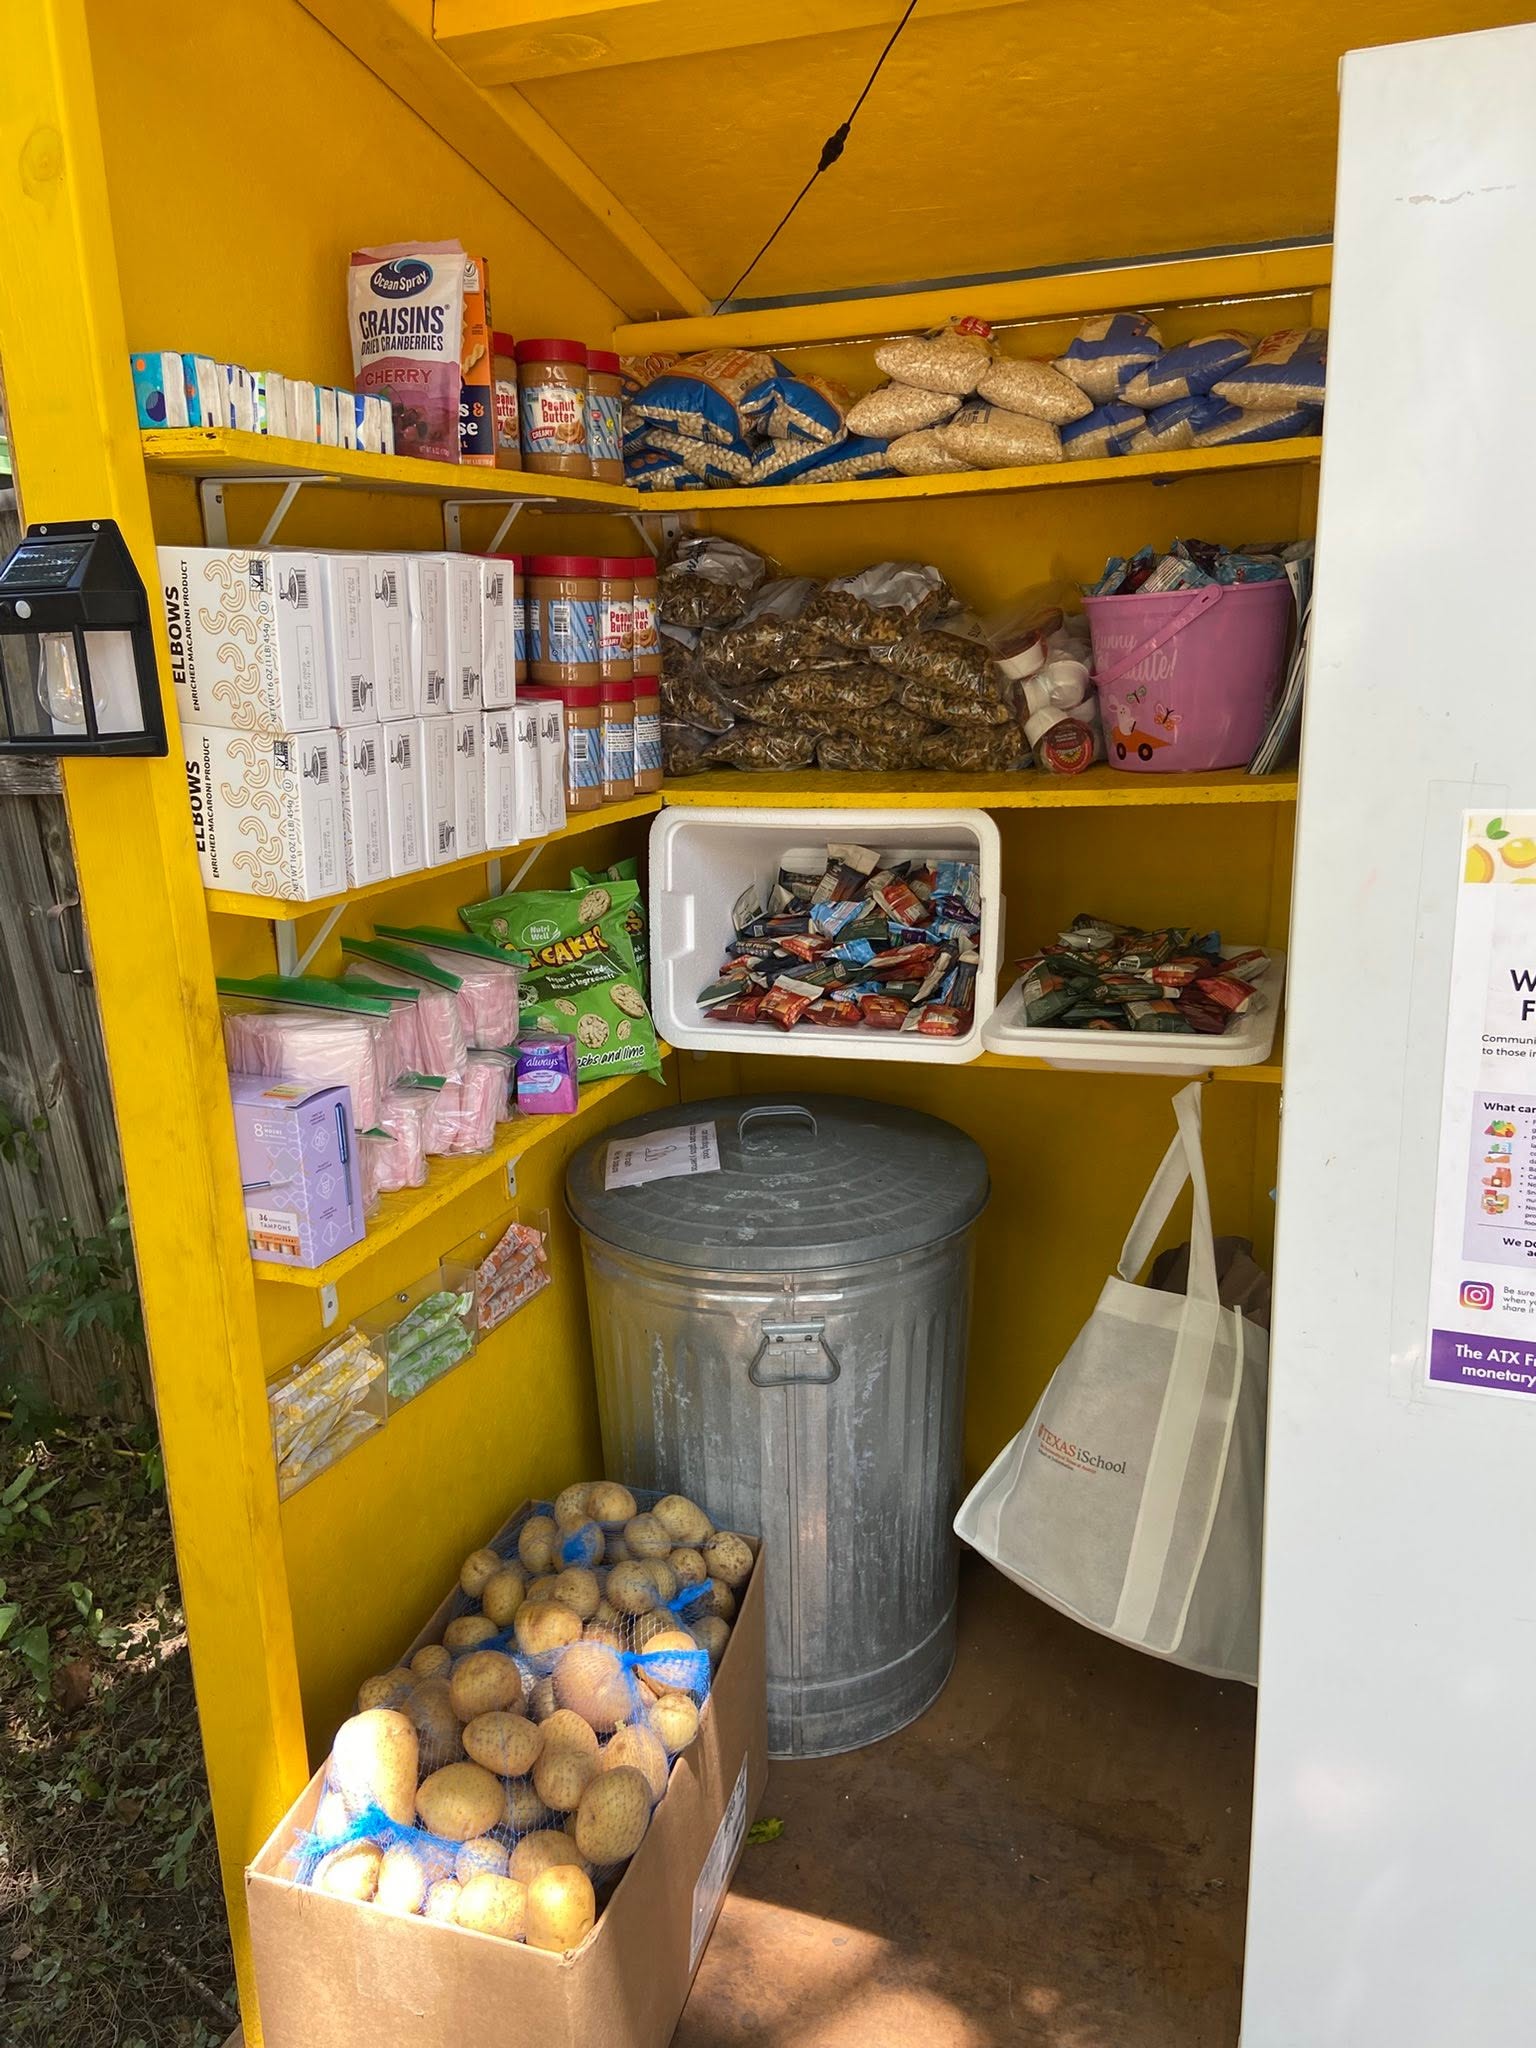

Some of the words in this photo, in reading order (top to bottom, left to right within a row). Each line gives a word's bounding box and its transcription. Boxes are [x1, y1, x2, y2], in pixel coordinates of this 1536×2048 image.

[373, 272, 399, 291] Ocean
[399, 270, 427, 292] Spray
[359, 305, 444, 340] CRAISINS
[361, 338, 379, 355] DRIED
[380, 334, 444, 352] CRANBERRIES
[365, 368, 432, 386] CHERRY
[496, 393, 515, 406] eanut
[541, 398, 576, 412] Peanut
[496, 405, 515, 417] utter
[542, 411, 576, 423] Butter
[531, 429, 554, 440] CREAMY
[180, 560, 189, 607] PRODUCT
[610, 611, 633, 622] Peanu
[165, 585, 187, 684] ELBOWS
[182, 610, 194, 663] MACARONI
[262, 623, 271, 644] 454g
[266, 668, 273, 681] OZ
[186, 664, 201, 712] ENRICHED
[267, 682, 274, 691] 16
[269, 708, 278, 723] NET
[202, 737, 212, 781] PRODUCT
[186, 760, 206, 852] ELBOWS
[204, 782, 215, 833] MACARONI
[286, 800, 295, 819] 454g
[289, 841, 297, 852] OZ
[207, 833, 220, 879] ENRICHED
[290, 853, 297, 862] 16
[530, 925, 550, 933] Nutri
[530, 932, 550, 941] Well
[577, 1053, 600, 1067] erbs
[601, 1048, 622, 1063] and
[623, 1046, 645, 1060] lime
[1482, 1047, 1494, 1056] to
[1496, 1047, 1527, 1058] those
[525, 1056, 559, 1069] always
[1484, 1101, 1516, 1112] What
[254, 1123, 264, 1137] 8
[260, 1222, 292, 1232] TAMPONS
[1503, 1237, 1521, 1247] We
[1503, 1286, 1515, 1294] Be
[1517, 1288, 1535, 1297] sure
[1503, 1296, 1526, 1305] when
[1502, 1303, 1526, 1313] share
[1455, 1343, 1482, 1360] The
[1487, 1348, 1520, 1365] ATX
[1462, 1366, 1536, 1388] monetary
[1042, 1426, 1076, 1457] TEXAS
[1076, 1448, 1127, 1474] iSchool
